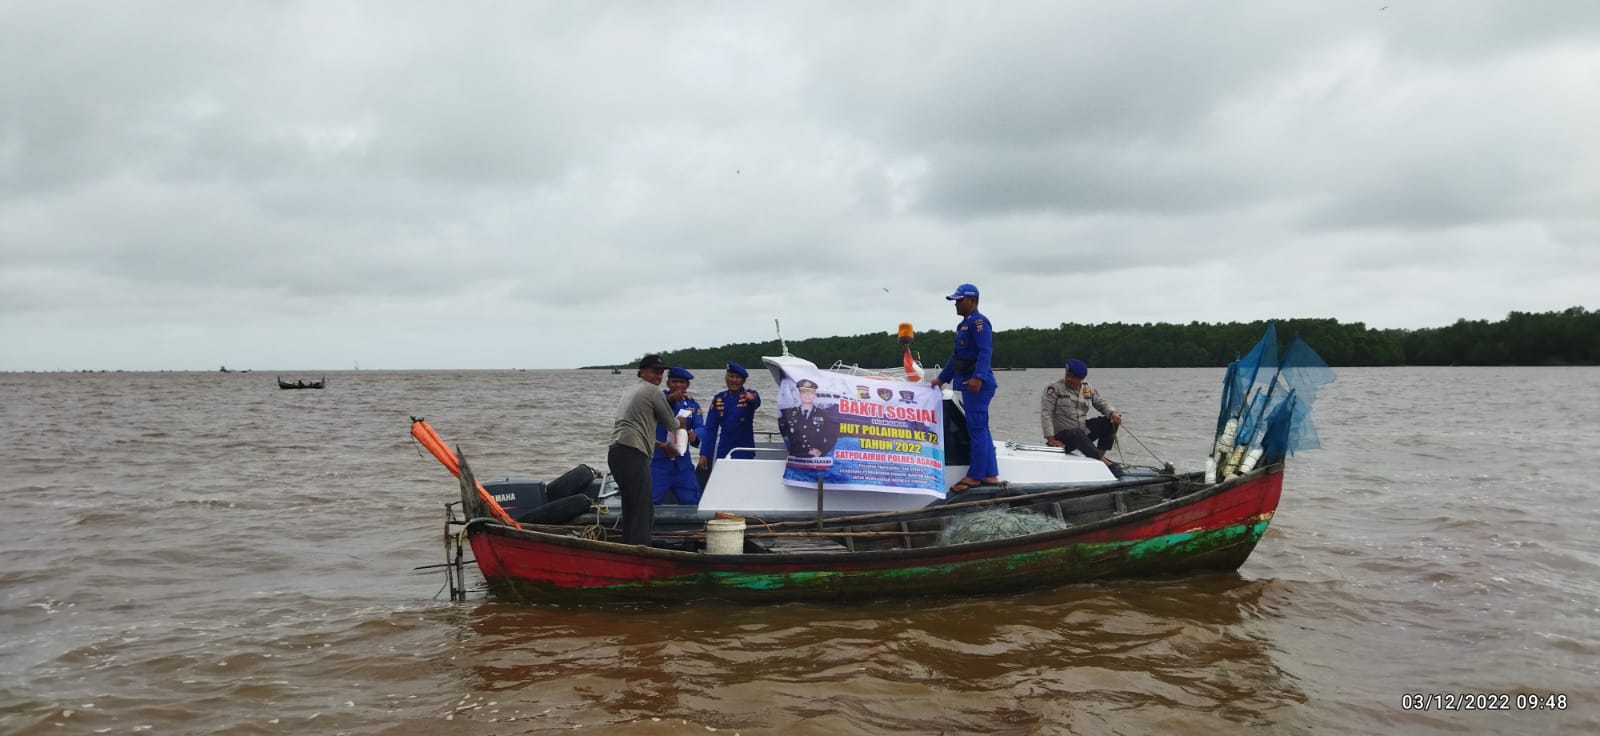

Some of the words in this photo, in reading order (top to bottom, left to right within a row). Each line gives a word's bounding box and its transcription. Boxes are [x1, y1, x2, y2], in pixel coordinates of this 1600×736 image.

[839, 398, 883, 417] BAKTI
[886, 405, 937, 424] SOSIAL
[840, 423, 860, 434] HUT
[862, 425, 912, 440] POLAIRUD
[914, 430, 926, 441] KE
[928, 432, 938, 445] 72
[860, 438, 893, 451] TAHUN
[895, 441, 922, 454] 2022
[835, 450, 885, 462] SATPOLAIRUD
[888, 454, 915, 465] POLRES
[491, 493, 515, 502] MAHA
